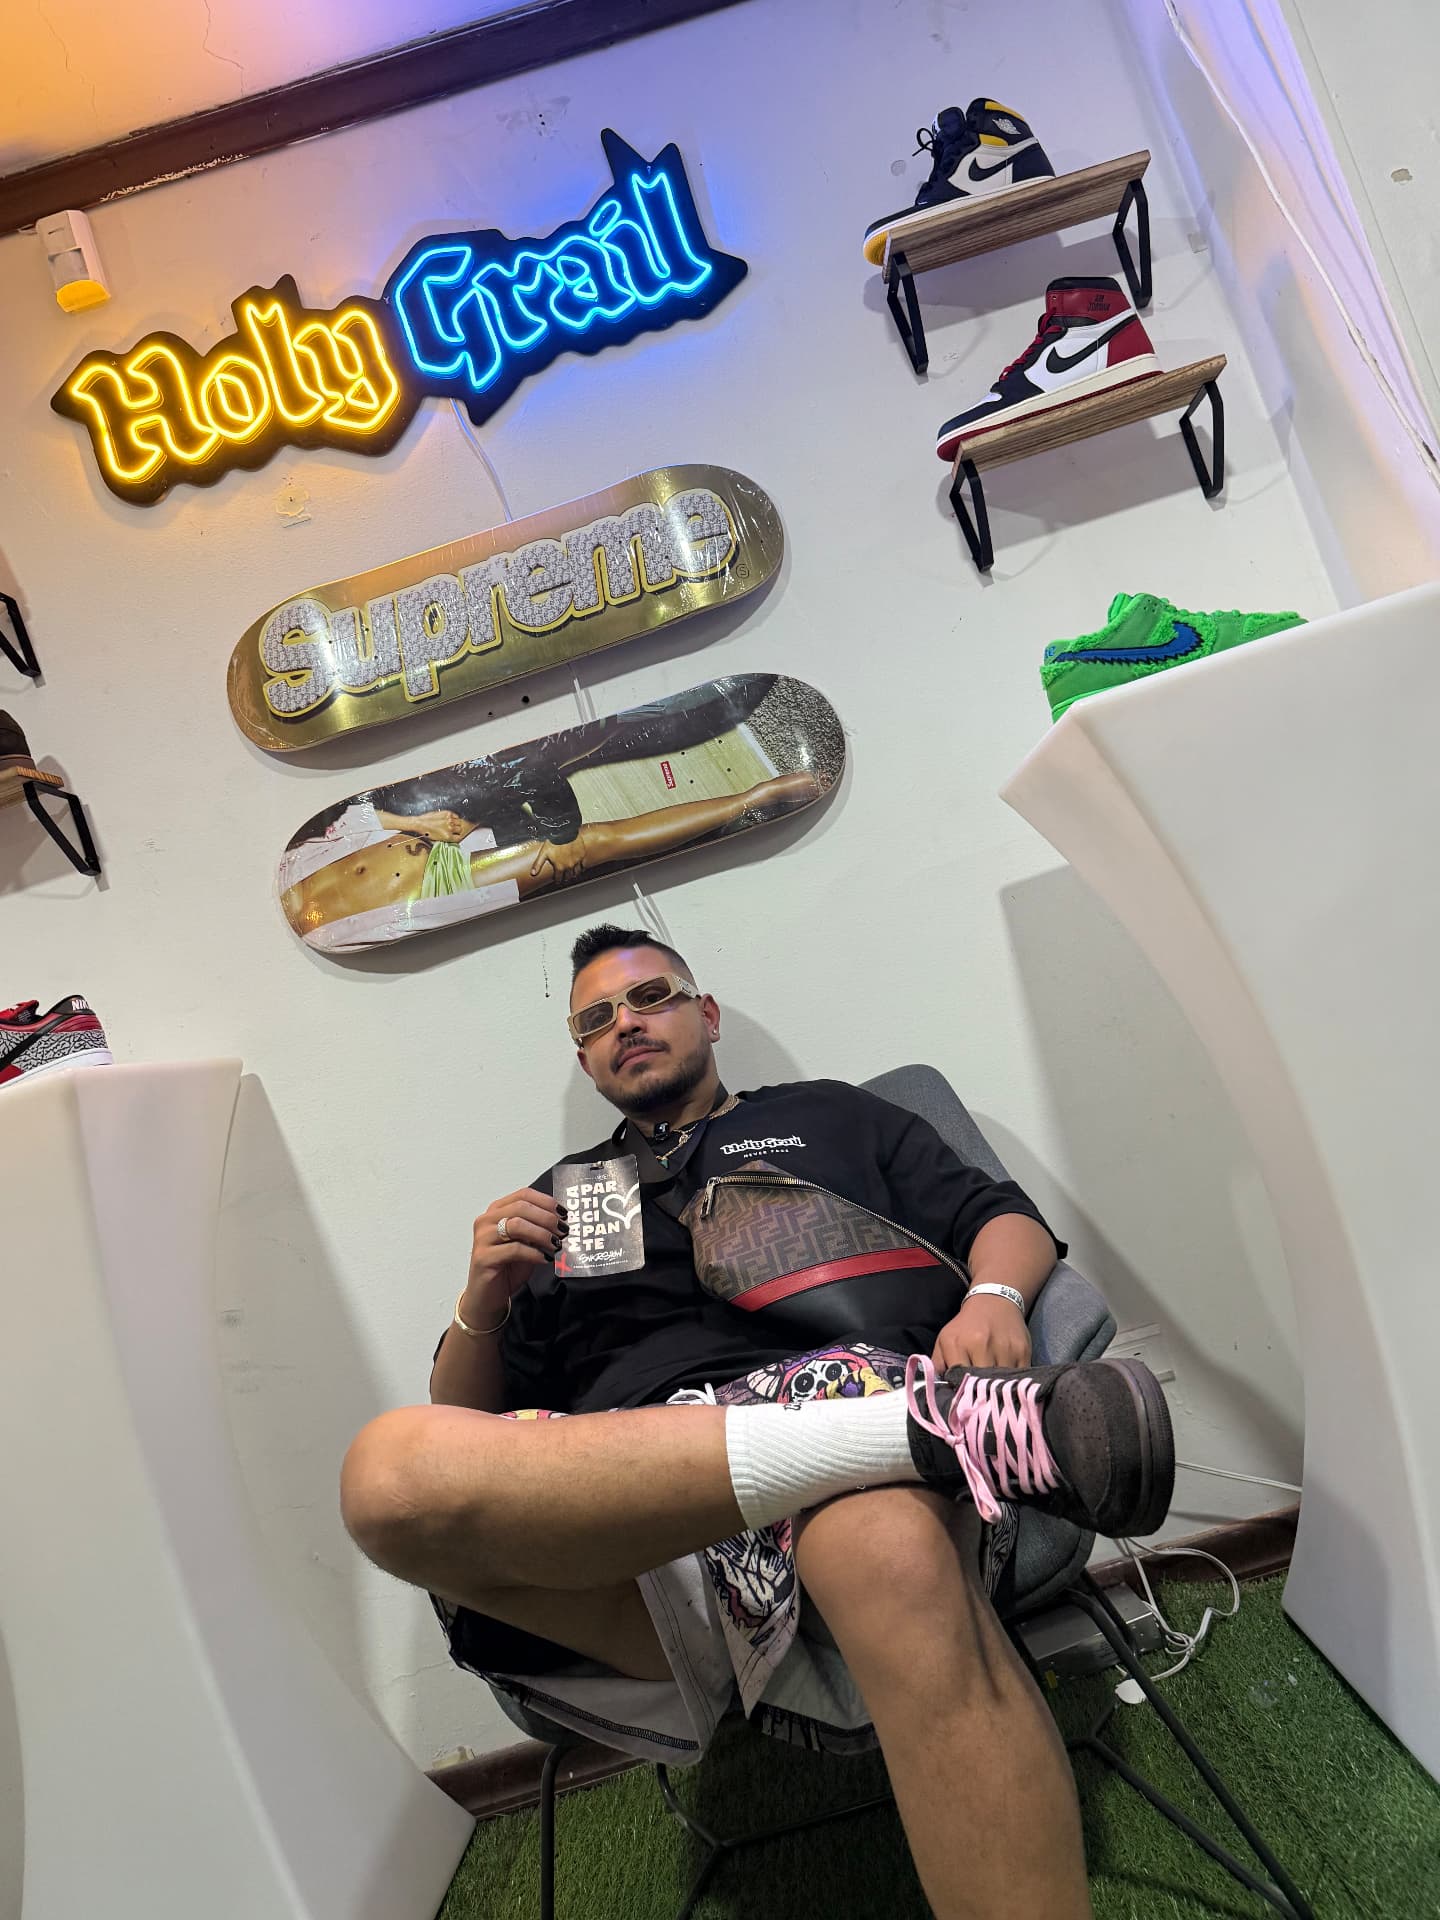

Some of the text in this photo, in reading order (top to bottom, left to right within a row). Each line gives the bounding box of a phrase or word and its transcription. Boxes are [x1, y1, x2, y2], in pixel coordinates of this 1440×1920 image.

[71, 172, 712, 482] Holy Grail
[259, 488, 738, 718] Supreme
[581, 1180, 617, 1196] PAR
[581, 1197, 599, 1209] TI
[582, 1210, 600, 1222] CI
[583, 1220, 620, 1237] PAN
[583, 1237, 605, 1251] TE
